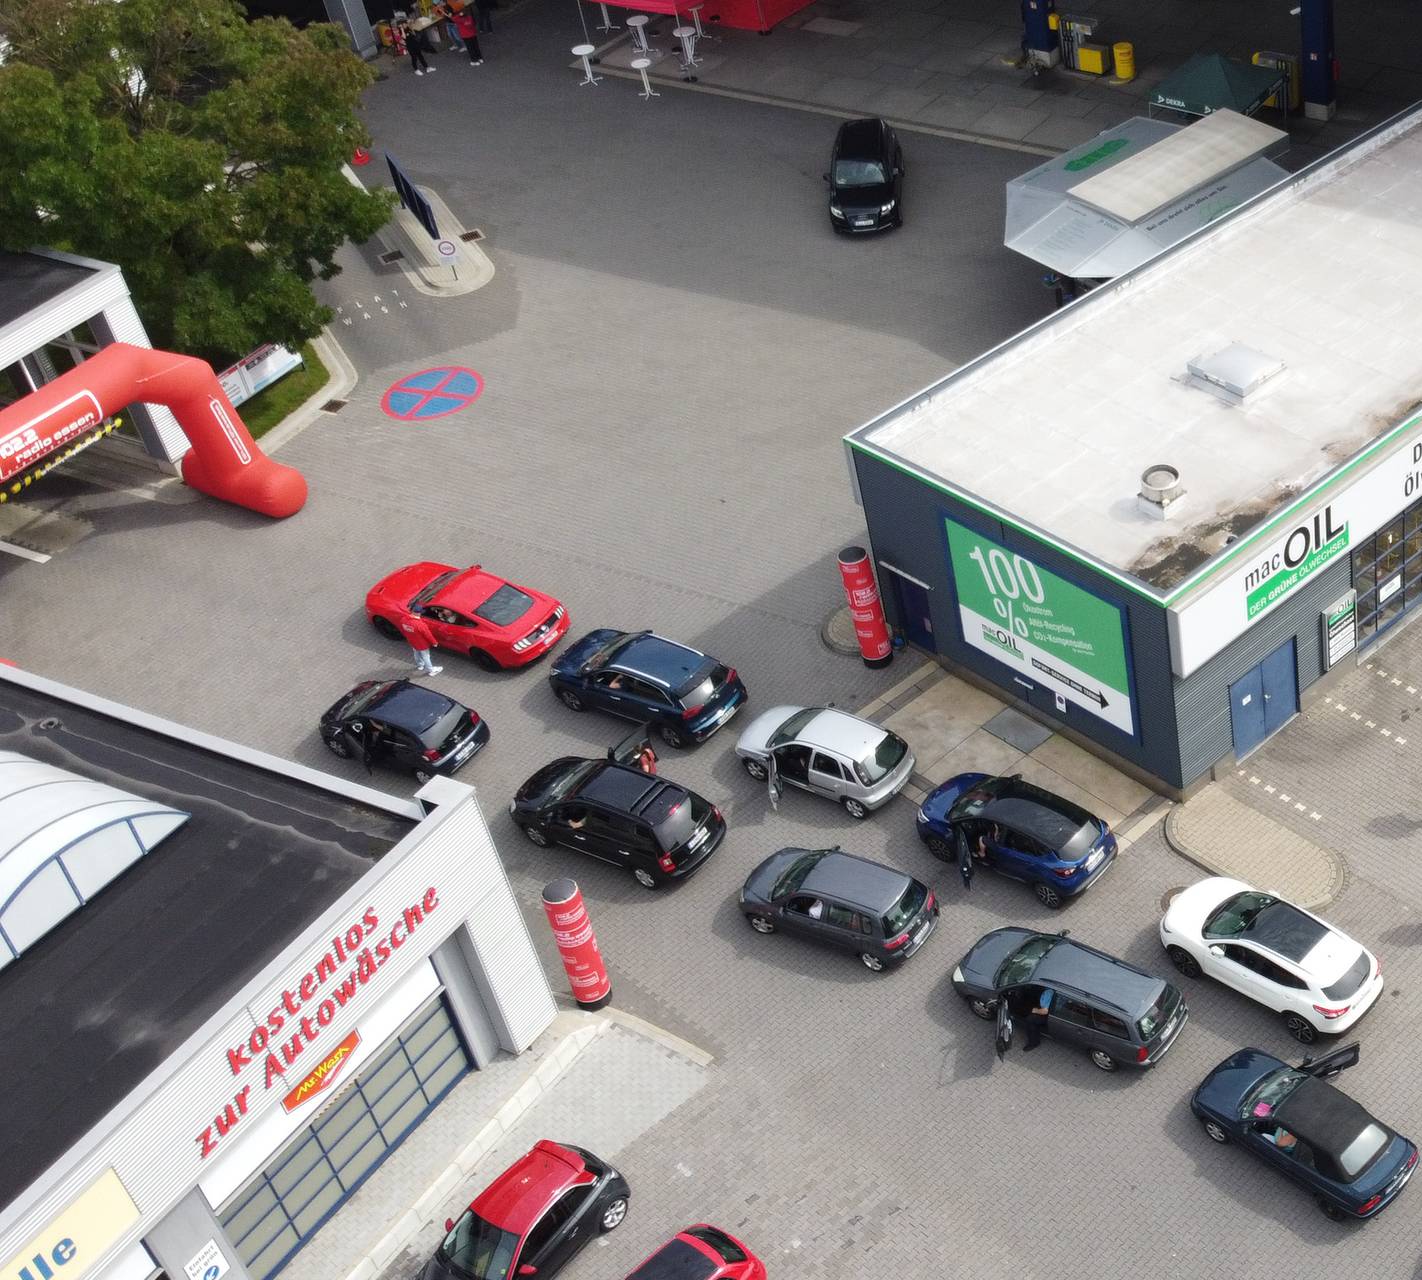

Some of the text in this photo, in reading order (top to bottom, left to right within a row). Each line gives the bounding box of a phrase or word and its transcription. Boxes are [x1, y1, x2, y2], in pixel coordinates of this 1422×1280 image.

[16, 412, 95, 463] radio essen
[969, 546, 1045, 604] 100
[1249, 538, 1347, 616] DER GRÜNE ÖLWECHSEL
[993, 597, 1029, 638] %
[227, 906, 379, 1076] kostenlos
[195, 886, 440, 1160] zur Autowäsche
[314, 1047, 350, 1079] Wash
